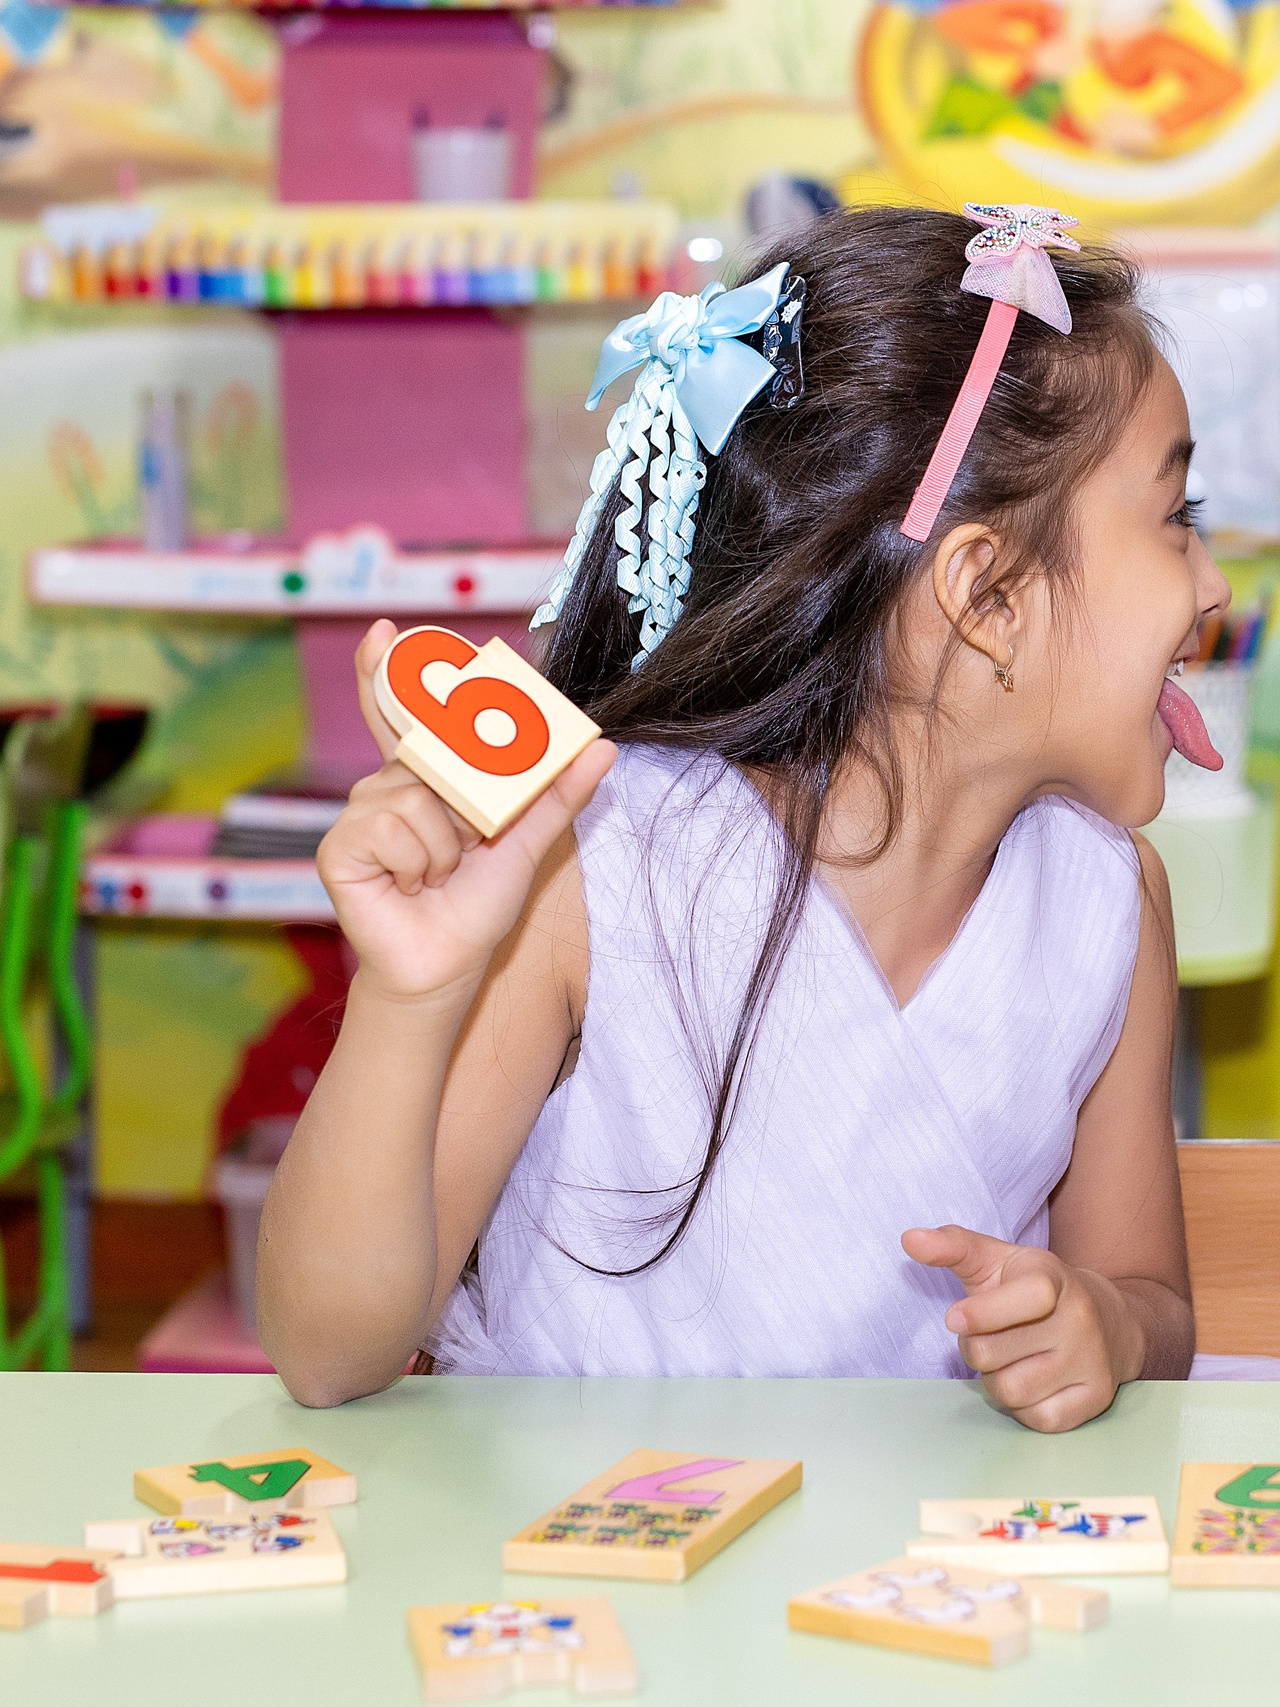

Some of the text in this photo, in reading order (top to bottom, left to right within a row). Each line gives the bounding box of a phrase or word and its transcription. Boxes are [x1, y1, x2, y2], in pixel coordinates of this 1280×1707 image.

[387, 629, 550, 776] 6
[187, 1458, 313, 1501] 4
[602, 1457, 748, 1505] 7
